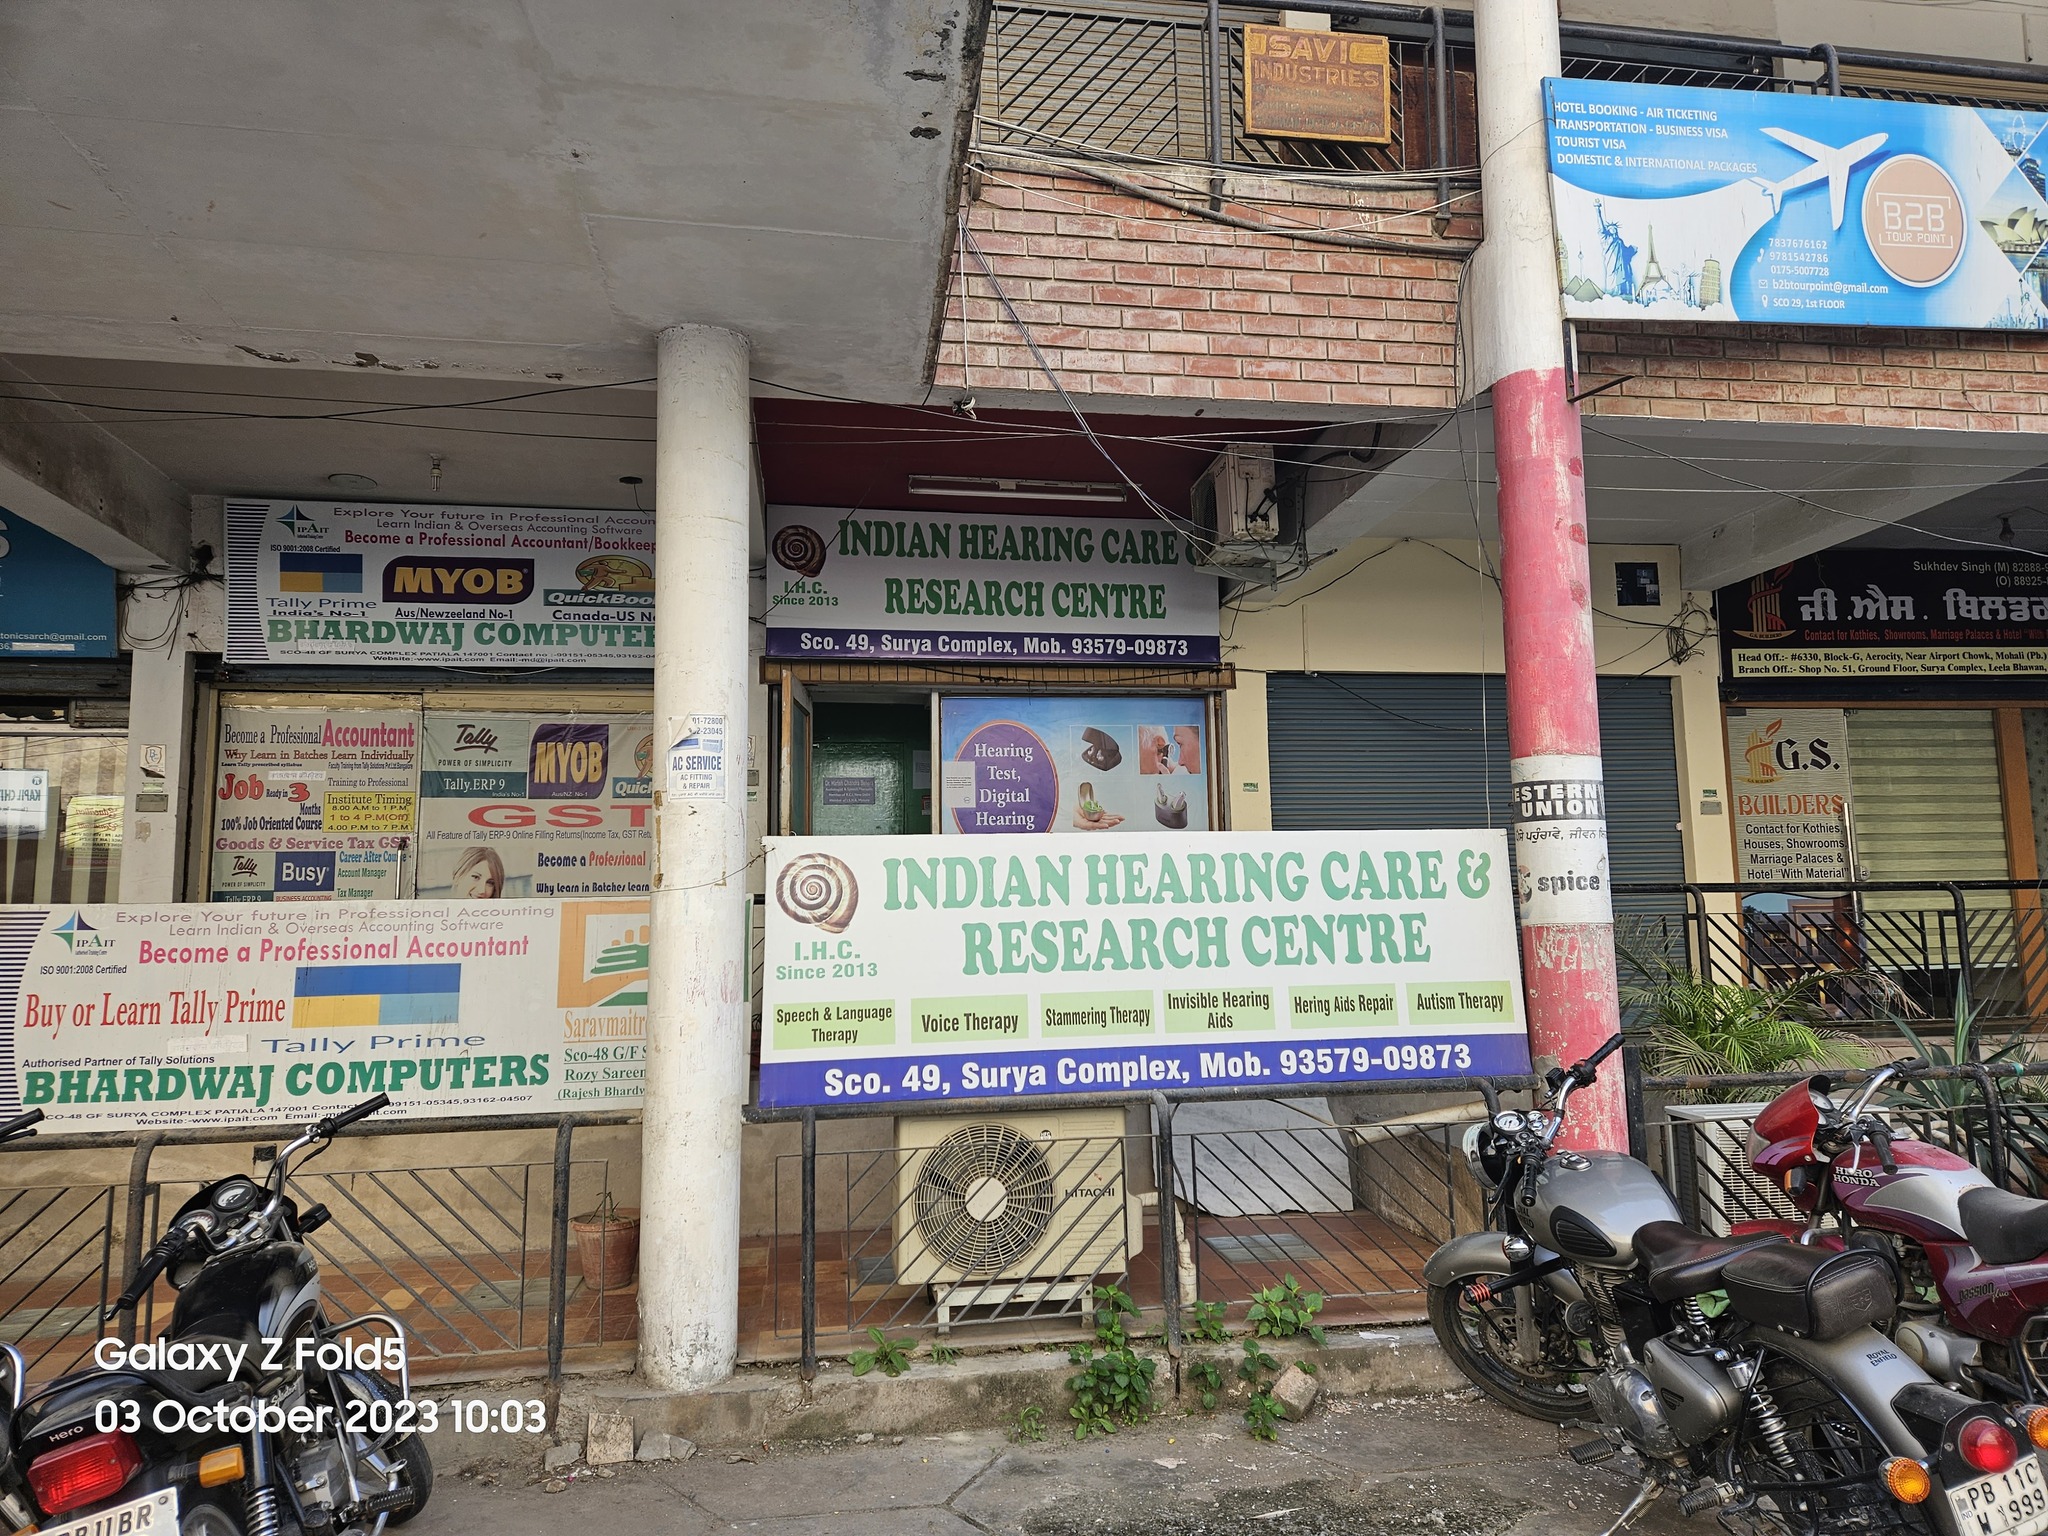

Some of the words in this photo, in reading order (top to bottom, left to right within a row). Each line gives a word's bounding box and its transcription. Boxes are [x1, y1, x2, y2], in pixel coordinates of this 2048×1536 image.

[1268, 35, 1347, 65] SAVI
[1254, 59, 1380, 87] INDUSTRIES
[1554, 101, 1586, 114] HOTEL
[1588, 103, 1638, 117] BOOKING
[1646, 107, 1664, 118] AIR
[1666, 108, 1718, 121] TICKETING
[1555, 119, 1647, 134] TRANSPORTATION
[1655, 124, 1703, 137] BUSINESS
[1704, 127, 1728, 139] VISA
[1555, 135, 1600, 149] TOURIST
[1602, 138, 1626, 150] VISA
[1557, 153, 1612, 166] DOMESTIC
[1614, 156, 1623, 167] &
[1625, 156, 1706, 171] INTERNATIONAL
[1708, 160, 1757, 173] PACKAGES
[1882, 201, 1945, 232] B2B
[1768, 238, 1828, 250] 7837676162
[1885, 231, 1912, 243] TOUR
[1917, 232, 1947, 244] POINT
[1769, 252, 1829, 263] 9781542786
[1770, 265, 1830, 277] 0175-5007728
[1772, 279, 1889, 294] b2btourpoint@gmail.com
[377, 519, 410, 529] Learn
[414, 520, 448, 530] Indian
[454, 521, 464, 531] &
[468, 522, 523, 532] Overseas
[526, 524, 587, 535] Accounting
[592, 525, 642, 535] Software
[838, 519, 951, 560] INDIAN
[958, 523, 1095, 563] HEARING
[1101, 529, 1179, 565] CARE
[1913, 561, 1959, 572] Sukhdev
[1961, 561, 1991, 574] Singh
[394, 566, 524, 596] MYOB
[784, 580, 828, 595] I.H.C.
[772, 594, 806, 606] Since
[809, 595, 839, 607] 2013
[884, 577, 1044, 618] RESEARCH
[1052, 581, 1167, 619] CENTRE
[267, 619, 465, 651] BHARDWAJ
[800, 633, 840, 651] Sco.
[846, 634, 875, 654] 49,
[881, 635, 932, 655] Surya
[937, 635, 1018, 656] Complex,
[1023, 637, 1066, 655] Mob.
[1072, 637, 1188, 656] 93579-09873
[1738, 653, 1761, 662] Head
[1790, 653, 1821, 662] #6330,
[1824, 653, 1863, 662] Block-G,
[1865, 652, 1903, 662] Aerocity,
[1905, 652, 1926, 661] Near
[1929, 652, 1960, 661] Airport
[1962, 651, 1993, 661] Chowk,
[1995, 651, 2025, 660] Mohali
[2027, 651, 2047, 661] (Pb.)
[224, 724, 258, 744] Become
[270, 724, 321, 744] Professional
[321, 718, 415, 747] Accountant
[454, 724, 498, 754] Tally
[534, 741, 603, 784] MYOB
[974, 742, 1033, 763] Hearing
[1776, 737, 1841, 771] G.S.
[672, 756, 683, 771] AC
[686, 756, 722, 771] SERVICE
[987, 765, 1021, 783] Test,
[218, 773, 264, 800] Job
[327, 794, 372, 804] Institute
[375, 794, 412, 806] Timing
[979, 787, 1031, 807] Digital
[1738, 794, 1844, 816] BUILDERS
[467, 804, 652, 828] GST
[1521, 799, 1598, 817] UNION
[975, 812, 1035, 832] Hearing
[1745, 823, 1784, 835] Contact
[1786, 823, 1800, 834] for
[1803, 822, 1843, 835] Kothies,
[1744, 838, 1784, 850] Houses,
[1750, 853, 1793, 866] Marriage
[1796, 853, 1834, 864] Palaces
[1837, 853, 1844, 863] &
[282, 862, 326, 886] Busy
[882, 855, 1072, 911] INDIAN
[1085, 850, 1309, 906] HEARING
[1321, 850, 1448, 900] CARE
[1457, 848, 1491, 899] &
[1537, 870, 1600, 895] spice
[1748, 868, 1773, 880] Hotel
[1776, 868, 1803, 879] “With
[139, 940, 229, 964] Become
[237, 945, 251, 962] a
[260, 935, 398, 963] Professional
[406, 934, 529, 960] Accountant
[794, 940, 861, 961] I.H.C.
[961, 916, 1231, 976] RESEARCH
[1241, 912, 1431, 967] CENTRE
[776, 965, 826, 980] Since
[832, 962, 878, 978] 2013
[1168, 992, 1219, 1010] Invisible
[1223, 991, 1270, 1011] Hearing
[1294, 995, 1331, 1017] Hering
[1334, 996, 1356, 1013] Aids
[1359, 995, 1394, 1015] Repair
[1417, 993, 1454, 1011] Autism
[1458, 992, 1504, 1012] Therapy
[23, 994, 67, 1040] Buy
[72, 1002, 95, 1027] or
[100, 992, 161, 1026] Learn
[169, 990, 219, 1037] Tally
[223, 988, 286, 1024] Prime
[776, 1006, 820, 1025] Speech
[823, 1007, 832, 1021] &
[836, 1005, 892, 1023] Language
[921, 1014, 960, 1033] Voice
[963, 1012, 1019, 1034] Therapy
[1045, 1008, 1107, 1028] Stammering
[1110, 1006, 1151, 1026] Therapy
[1207, 1012, 1234, 1029] Aids
[811, 1027, 858, 1043] Therapy
[22, 1057, 81, 1068] Authorised
[84, 1056, 123, 1067] Partner
[125, 1055, 136, 1066] of
[139, 1055, 163, 1067] Tally
[166, 1055, 215, 1065] Solutions
[824, 1068, 891, 1097] Sco.
[902, 1065, 951, 1096] 49,
[961, 1061, 1046, 1093] Surya
[1057, 1055, 1190, 1085] Complex,
[1200, 1052, 1271, 1080] Mob.
[1280, 1043, 1472, 1077] 93579-09873
[22, 1065, 275, 1107] BHARDWAJ
[286, 1053, 550, 1097] COMPUTERS
[1833, 1174, 1881, 1188] HONDA
[1065, 1188, 1115, 1198] HITACHI
[1866, 1349, 1890, 1360] ROYAL
[49, 1425, 84, 1443] Hero
[1967, 1481, 1995, 1510] PB
[2002, 1462, 2038, 1496] 11C
